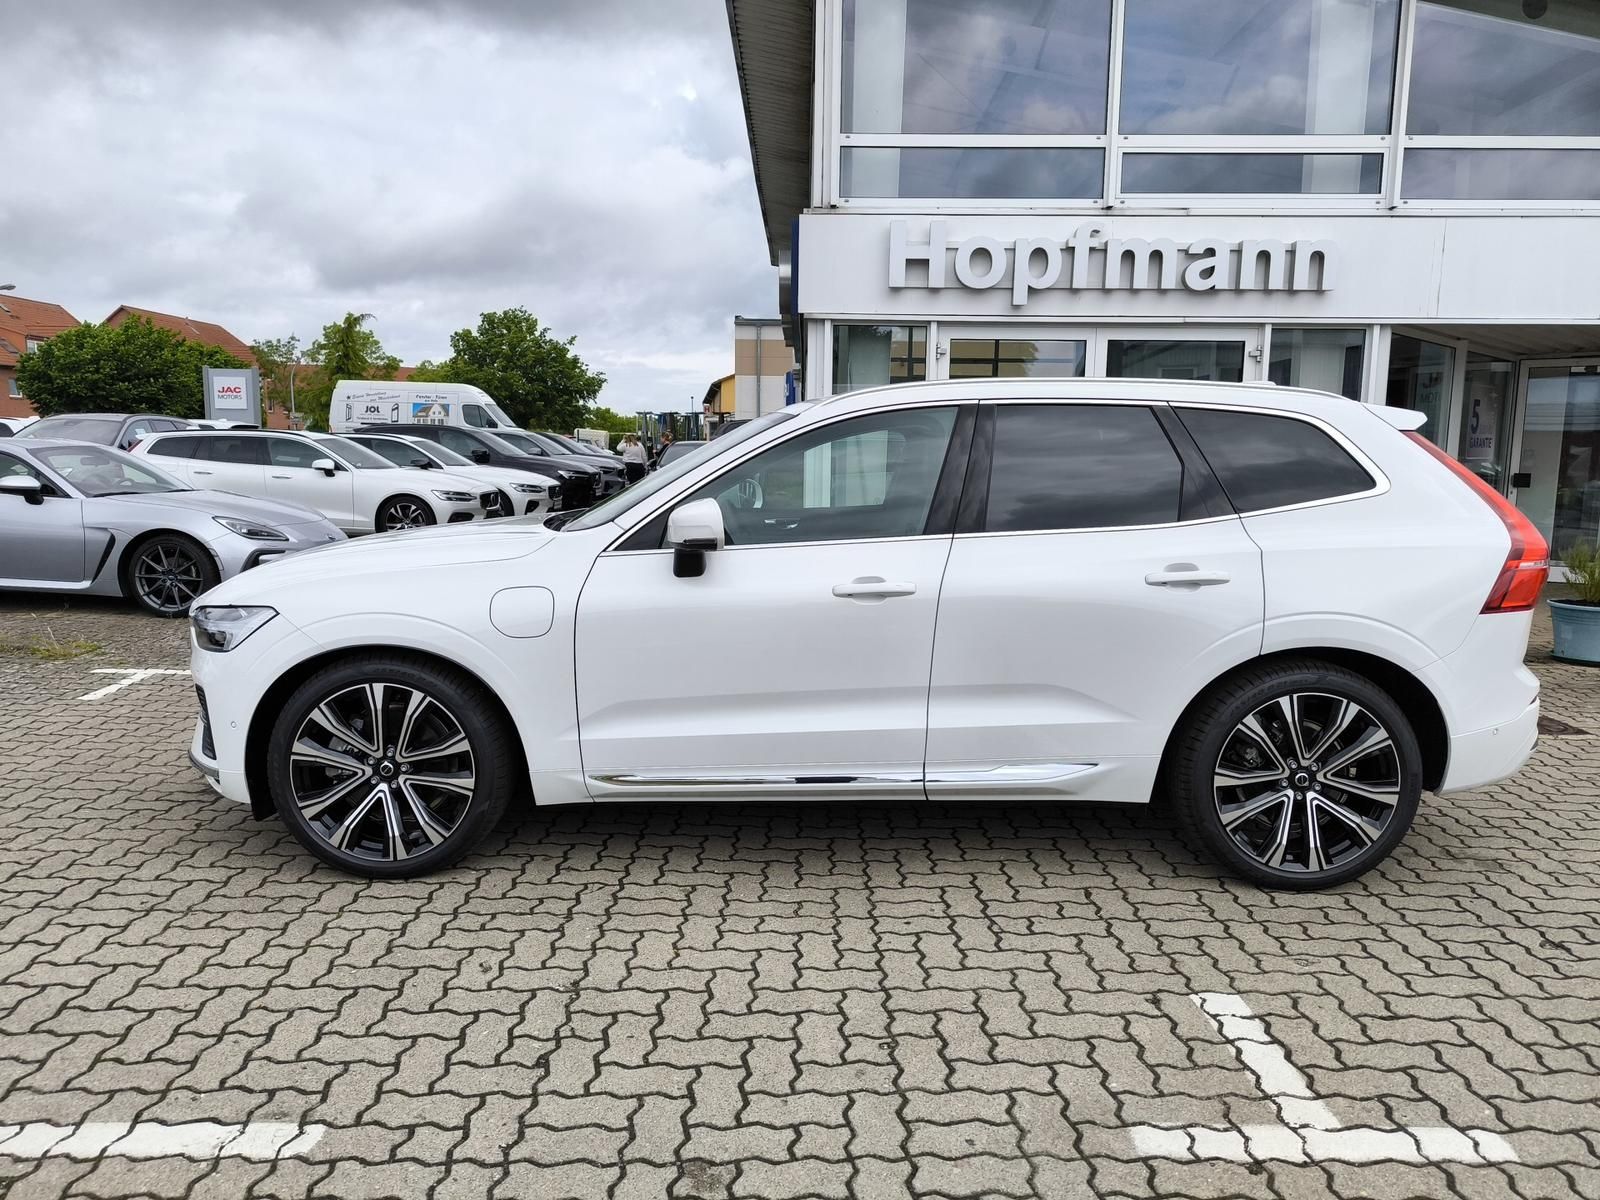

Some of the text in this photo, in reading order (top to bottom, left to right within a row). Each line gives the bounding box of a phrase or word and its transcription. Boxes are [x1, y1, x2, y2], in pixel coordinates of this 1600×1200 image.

[888, 220, 1335, 306] Hopfmann
[217, 386, 242, 394] JAC
[364, 405, 381, 414] JOL
[1471, 399, 1480, 434] 5
